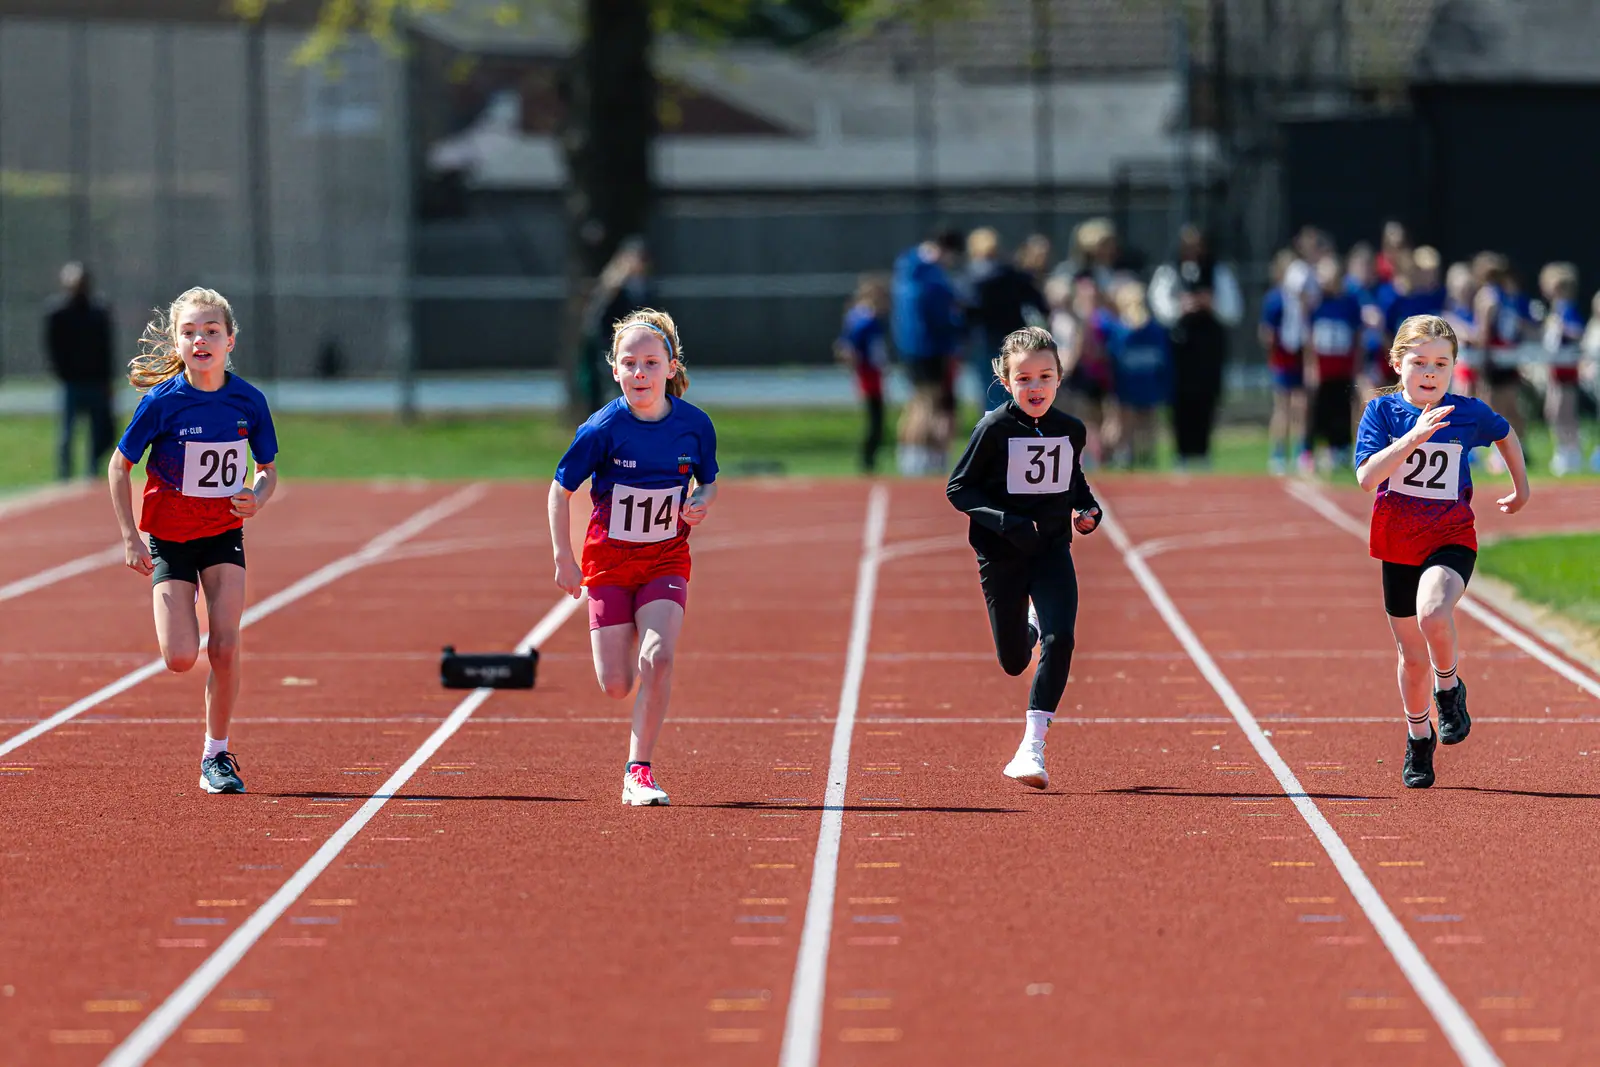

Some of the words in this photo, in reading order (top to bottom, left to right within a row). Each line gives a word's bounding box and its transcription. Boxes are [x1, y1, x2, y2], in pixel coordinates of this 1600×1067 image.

[197, 448, 239, 488] 26
[1024, 444, 1061, 485] 31
[1402, 447, 1449, 490] 22
[618, 494, 674, 533] 114
